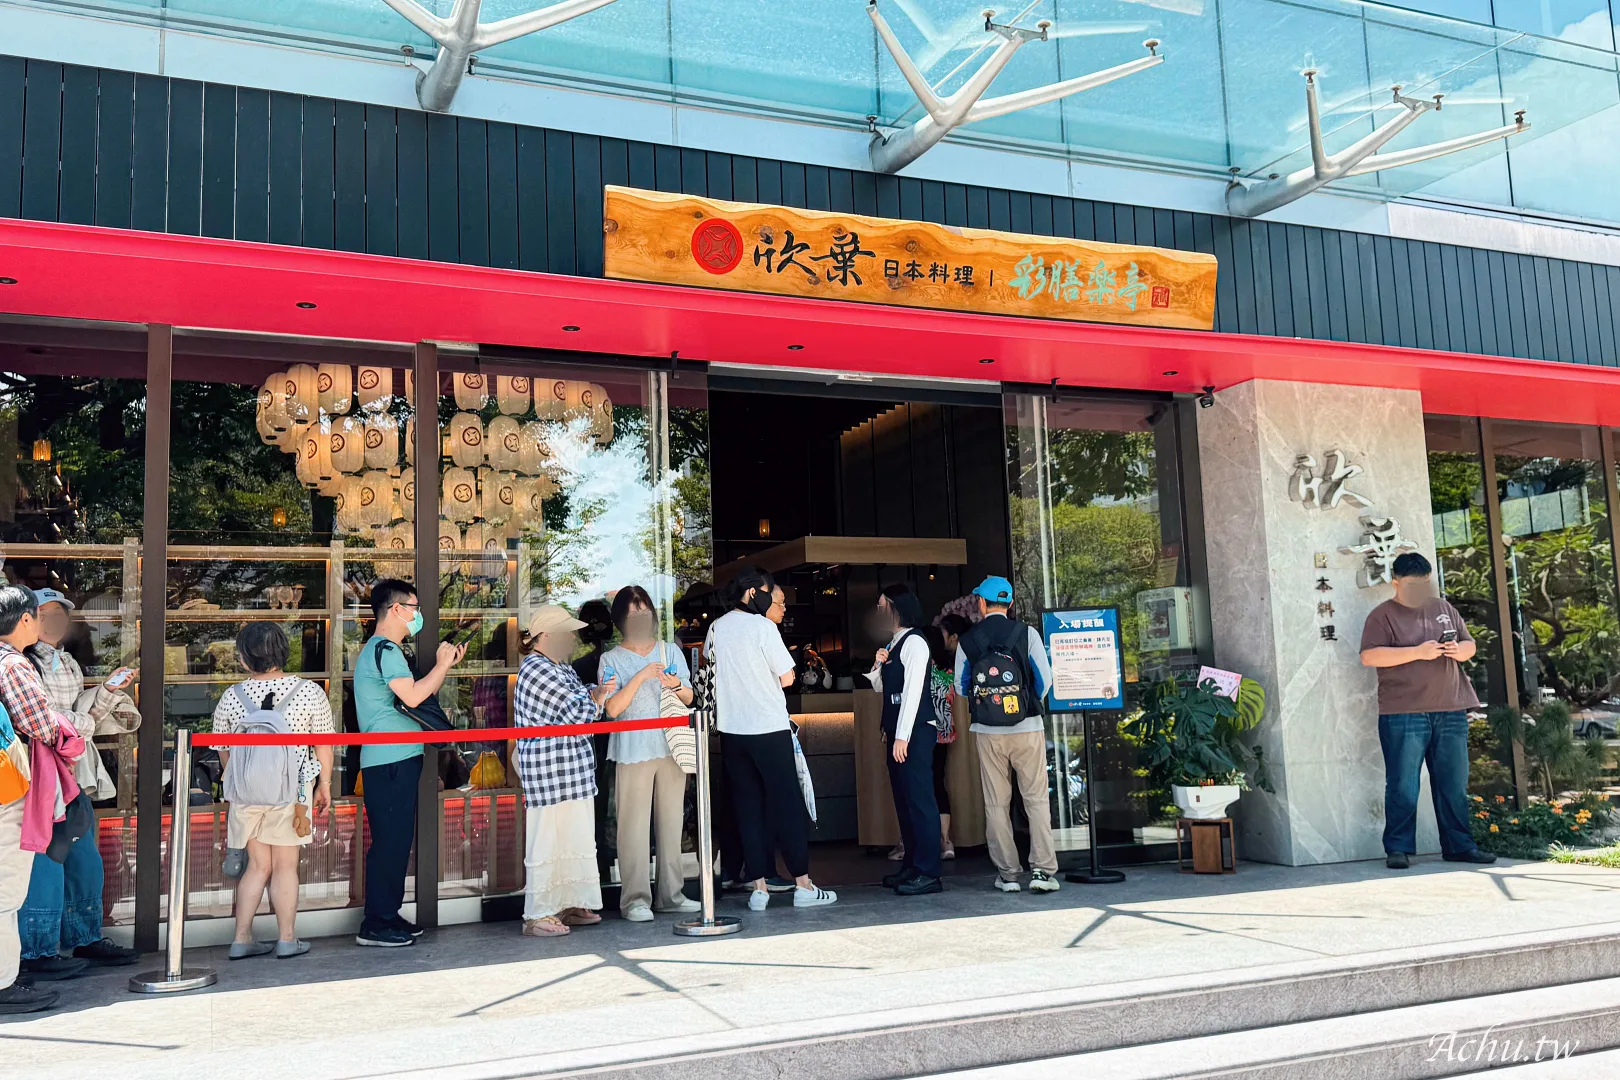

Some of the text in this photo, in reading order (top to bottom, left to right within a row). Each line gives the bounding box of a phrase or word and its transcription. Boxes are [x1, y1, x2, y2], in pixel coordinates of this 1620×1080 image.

[753, 229, 876, 287] 欣葉
[883, 259, 975, 286] 日本料理
[1314, 552, 1338, 641] 日本料理
